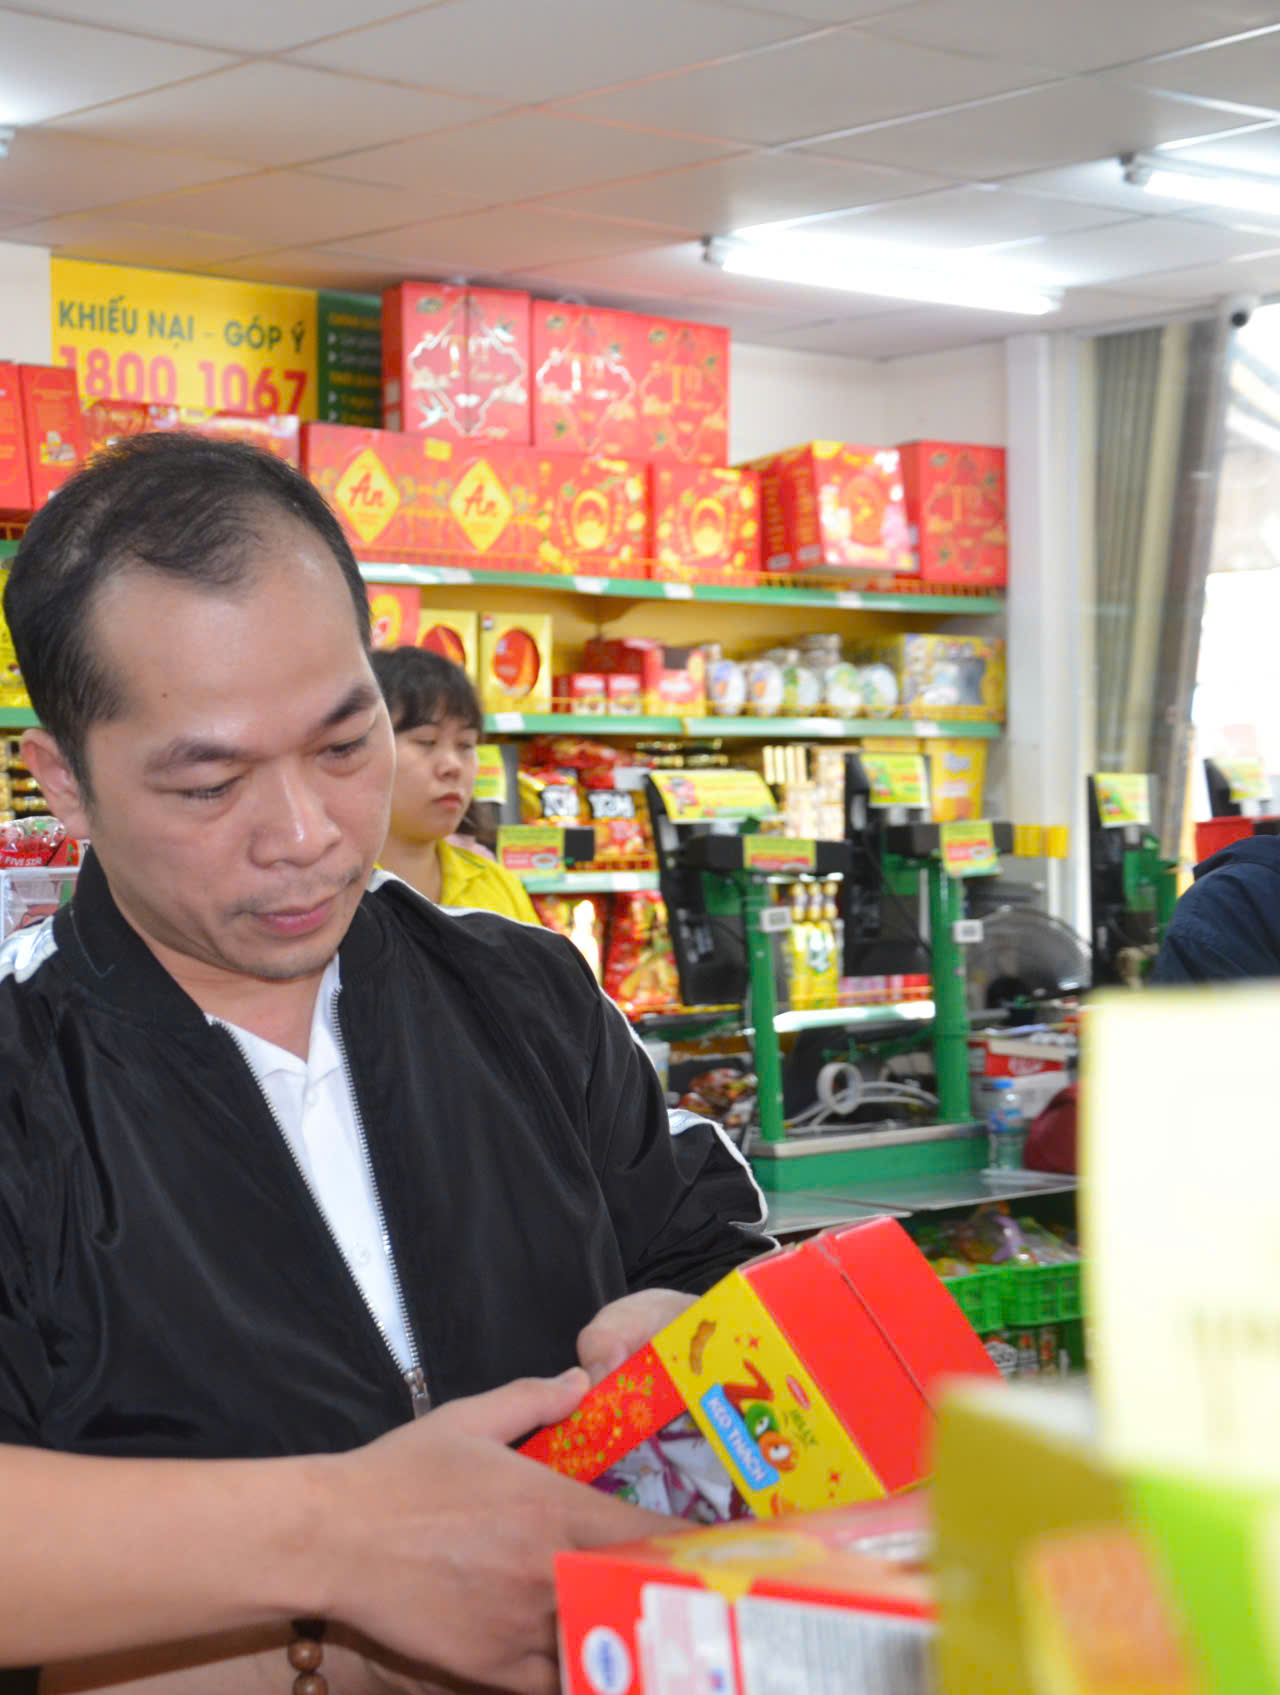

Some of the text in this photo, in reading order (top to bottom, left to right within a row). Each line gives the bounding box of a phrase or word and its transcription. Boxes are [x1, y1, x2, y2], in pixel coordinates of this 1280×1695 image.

[58, 295, 138, 336] KHIẾU
[147, 309, 194, 349] NẠI
[224, 315, 282, 351] GÓP
[291, 320, 305, 354] Ý
[199, 361, 307, 414] 1067
